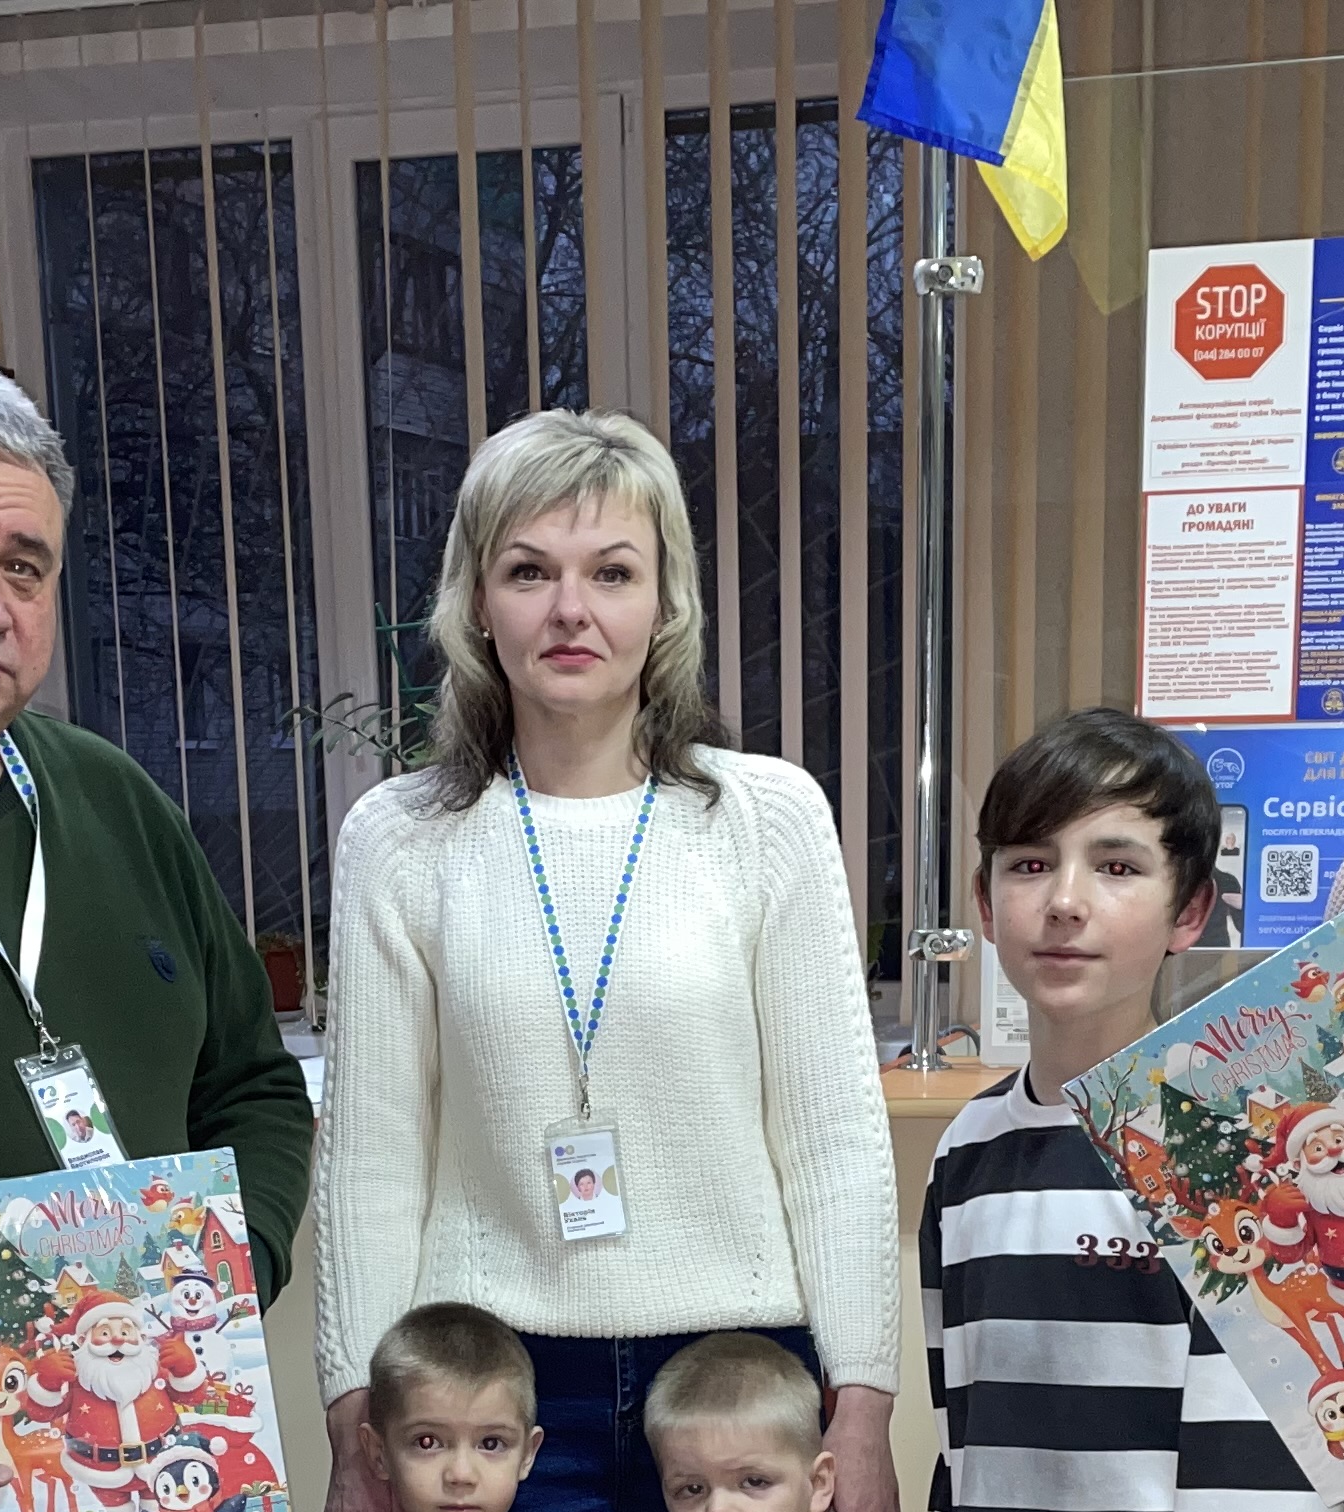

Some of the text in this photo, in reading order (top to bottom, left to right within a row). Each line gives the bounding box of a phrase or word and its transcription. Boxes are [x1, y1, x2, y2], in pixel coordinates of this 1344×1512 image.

[1196, 283, 1267, 320] STOP
[1195, 318, 1267, 341] КОРУПЦІЇ
[1219, 348, 1235, 360] 284
[1237, 348, 1250, 358] 00
[1252, 346, 1264, 358] 07
[1186, 502, 1247, 517] ДО УВАГИ
[1182, 519, 1254, 532] ГРОМАДЯН!
[1191, 1005, 1312, 1081] Merry
[1211, 1026, 1307, 1095] CHRISTMAS
[39, 1225, 135, 1257] CHRISTMAS
